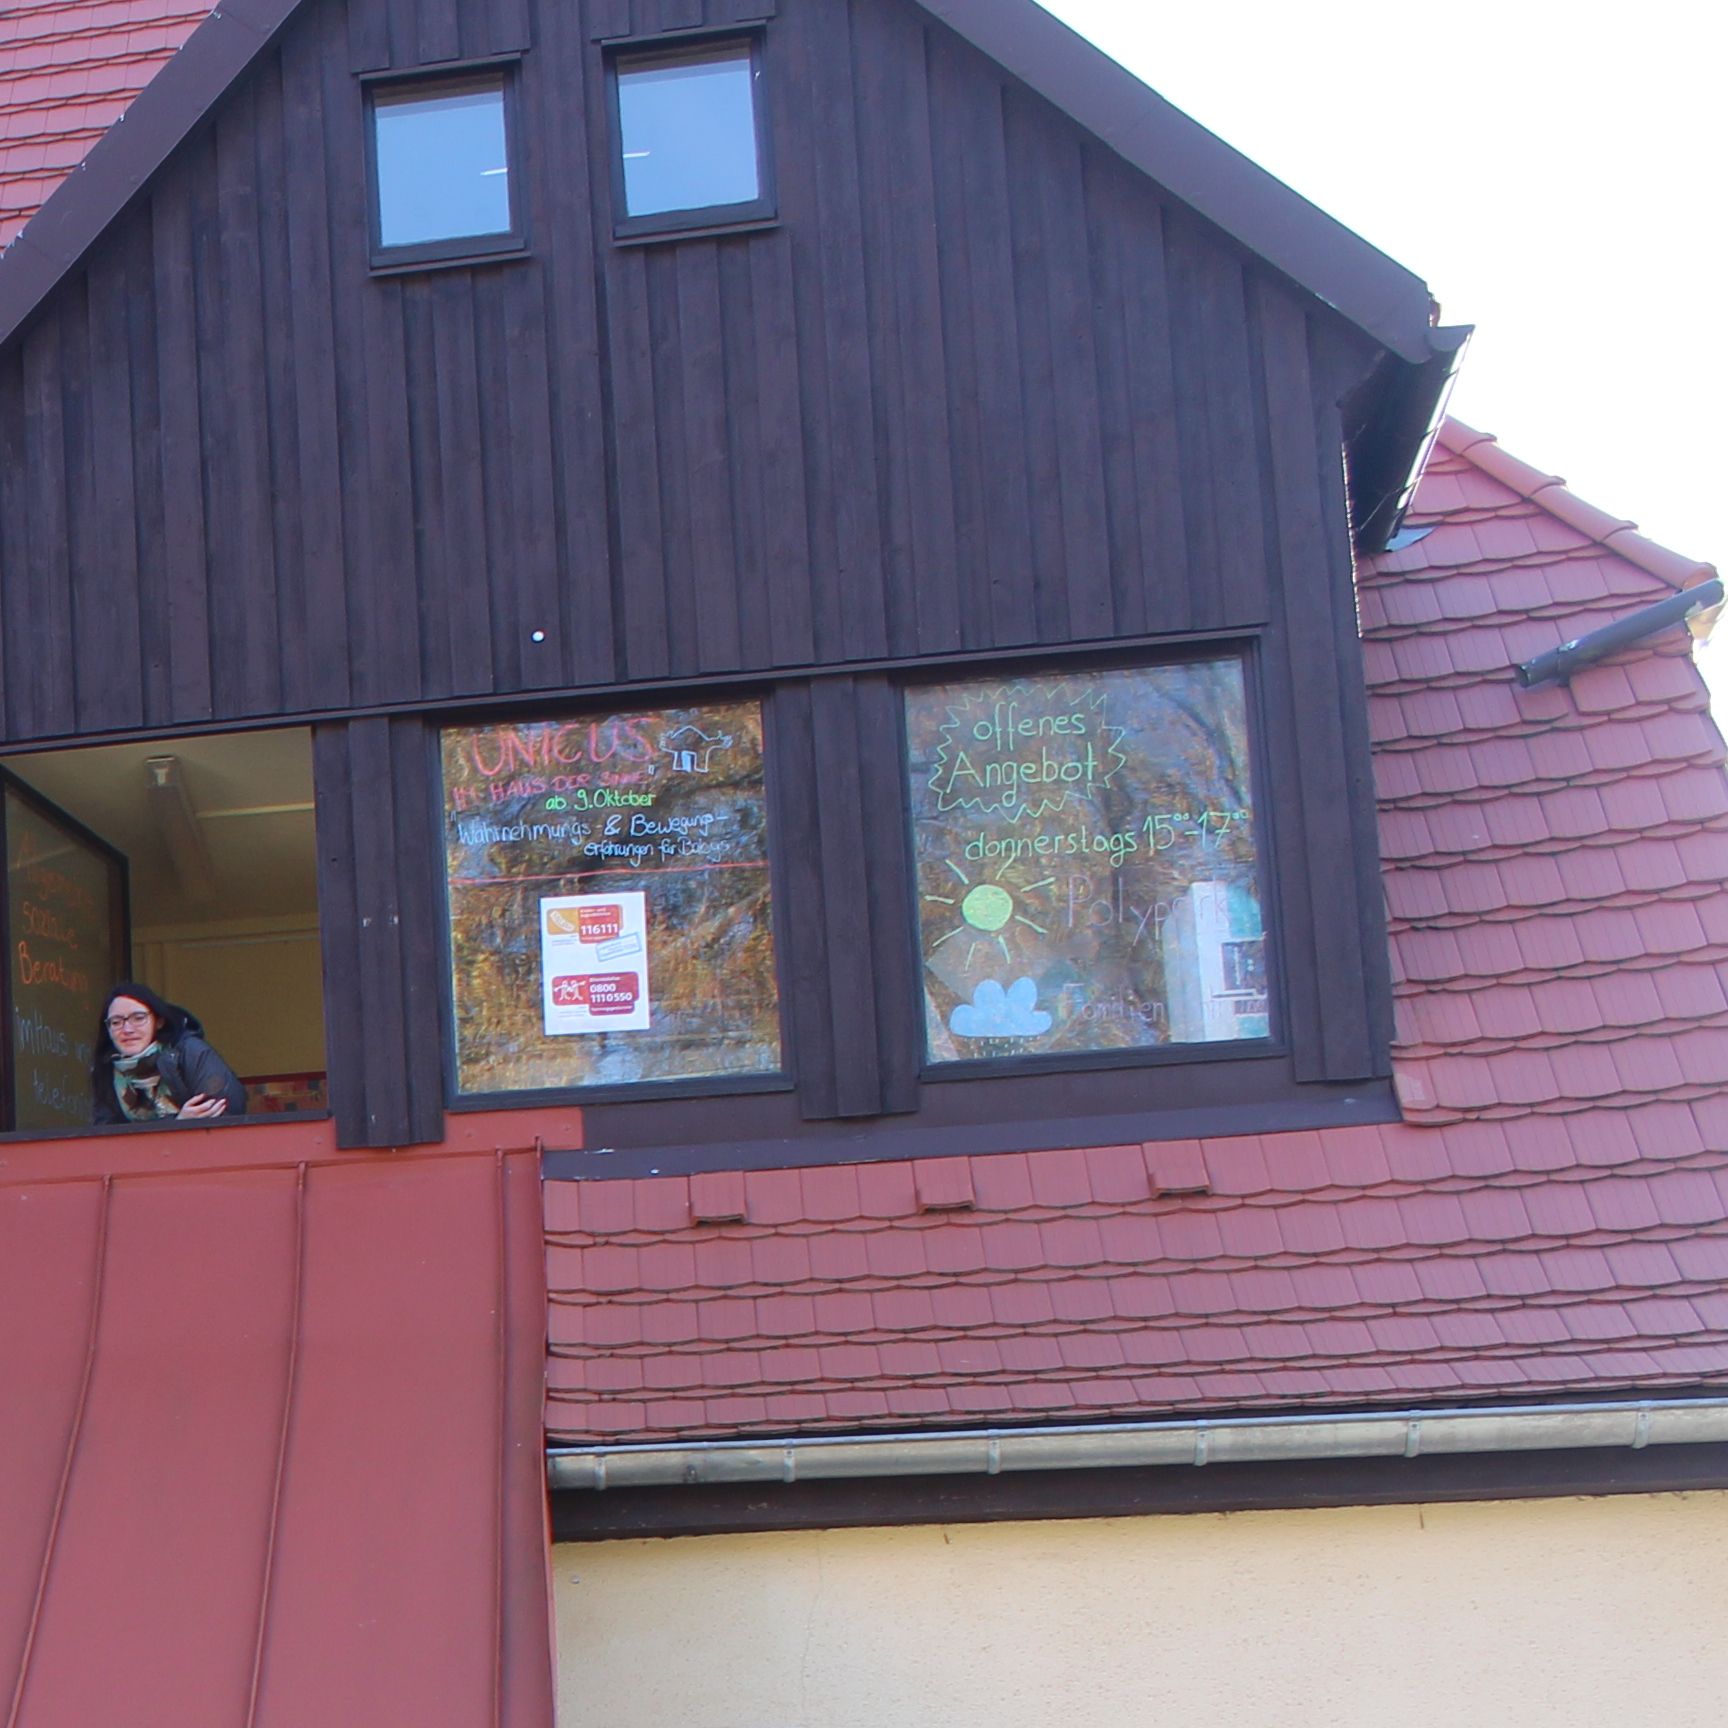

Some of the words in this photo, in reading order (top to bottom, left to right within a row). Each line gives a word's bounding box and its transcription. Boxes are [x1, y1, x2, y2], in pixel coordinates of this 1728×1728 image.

[972, 702, 1086, 752] offenes
[471, 716, 662, 776] UNICUS
[946, 742, 1099, 808] Angebot
[546, 793, 567, 811] ab
[964, 826, 1138, 868] donnerstags
[580, 923, 619, 936] 116111
[589, 983, 617, 993] 0800
[590, 992, 633, 1003] 1110550
